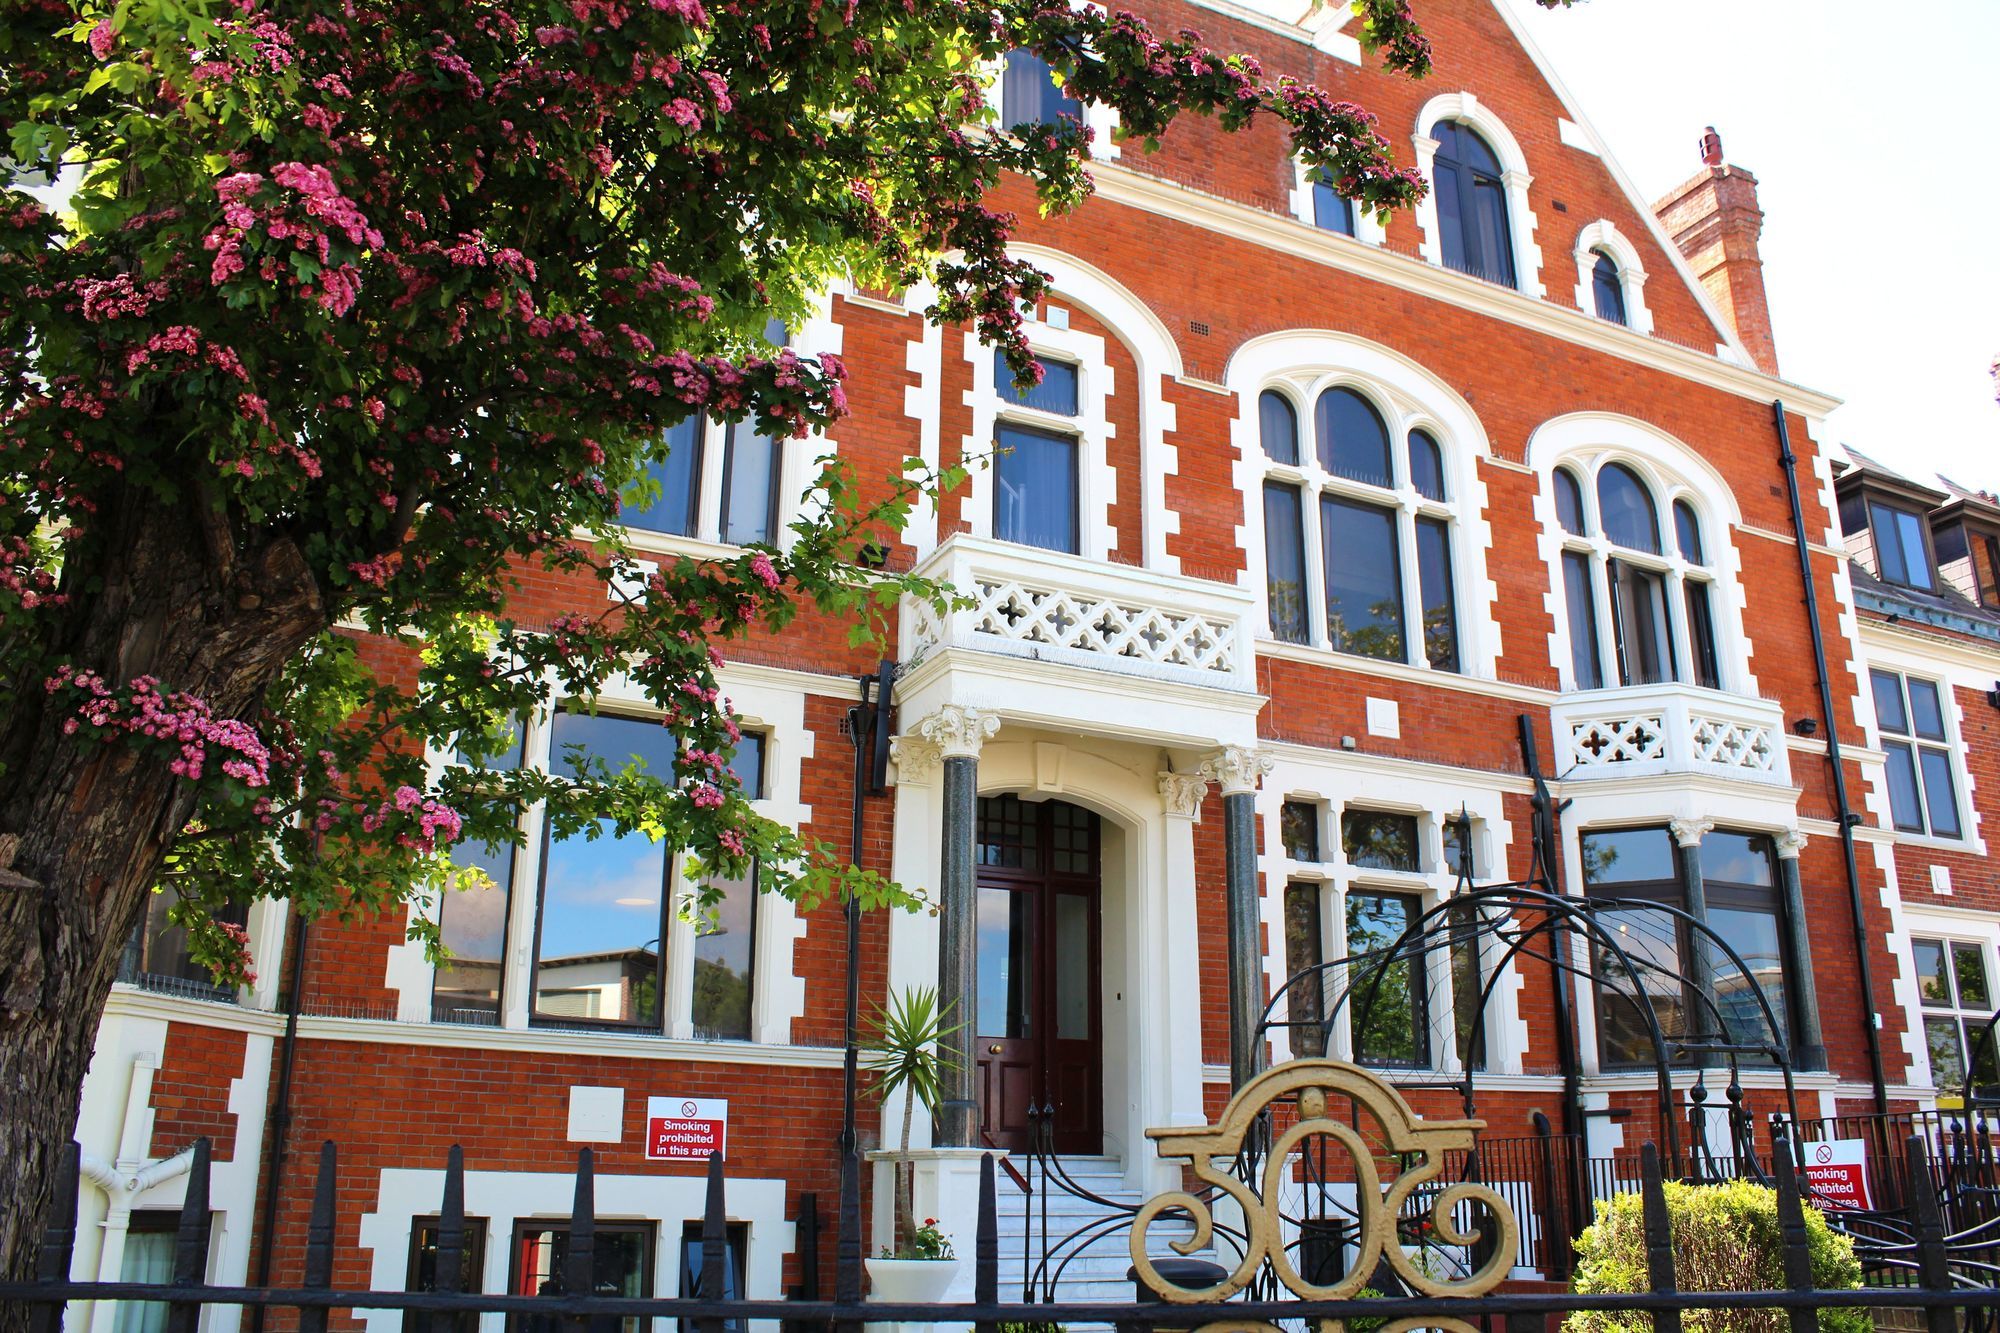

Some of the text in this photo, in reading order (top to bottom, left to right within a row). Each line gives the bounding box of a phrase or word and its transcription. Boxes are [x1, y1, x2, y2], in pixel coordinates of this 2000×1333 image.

[664, 1120, 710, 1133] Smoking
[660, 1133, 714, 1144] prohibited
[657, 1144, 667, 1154] in
[670, 1145, 689, 1155] this
[1806, 1168, 1847, 1180] moking
